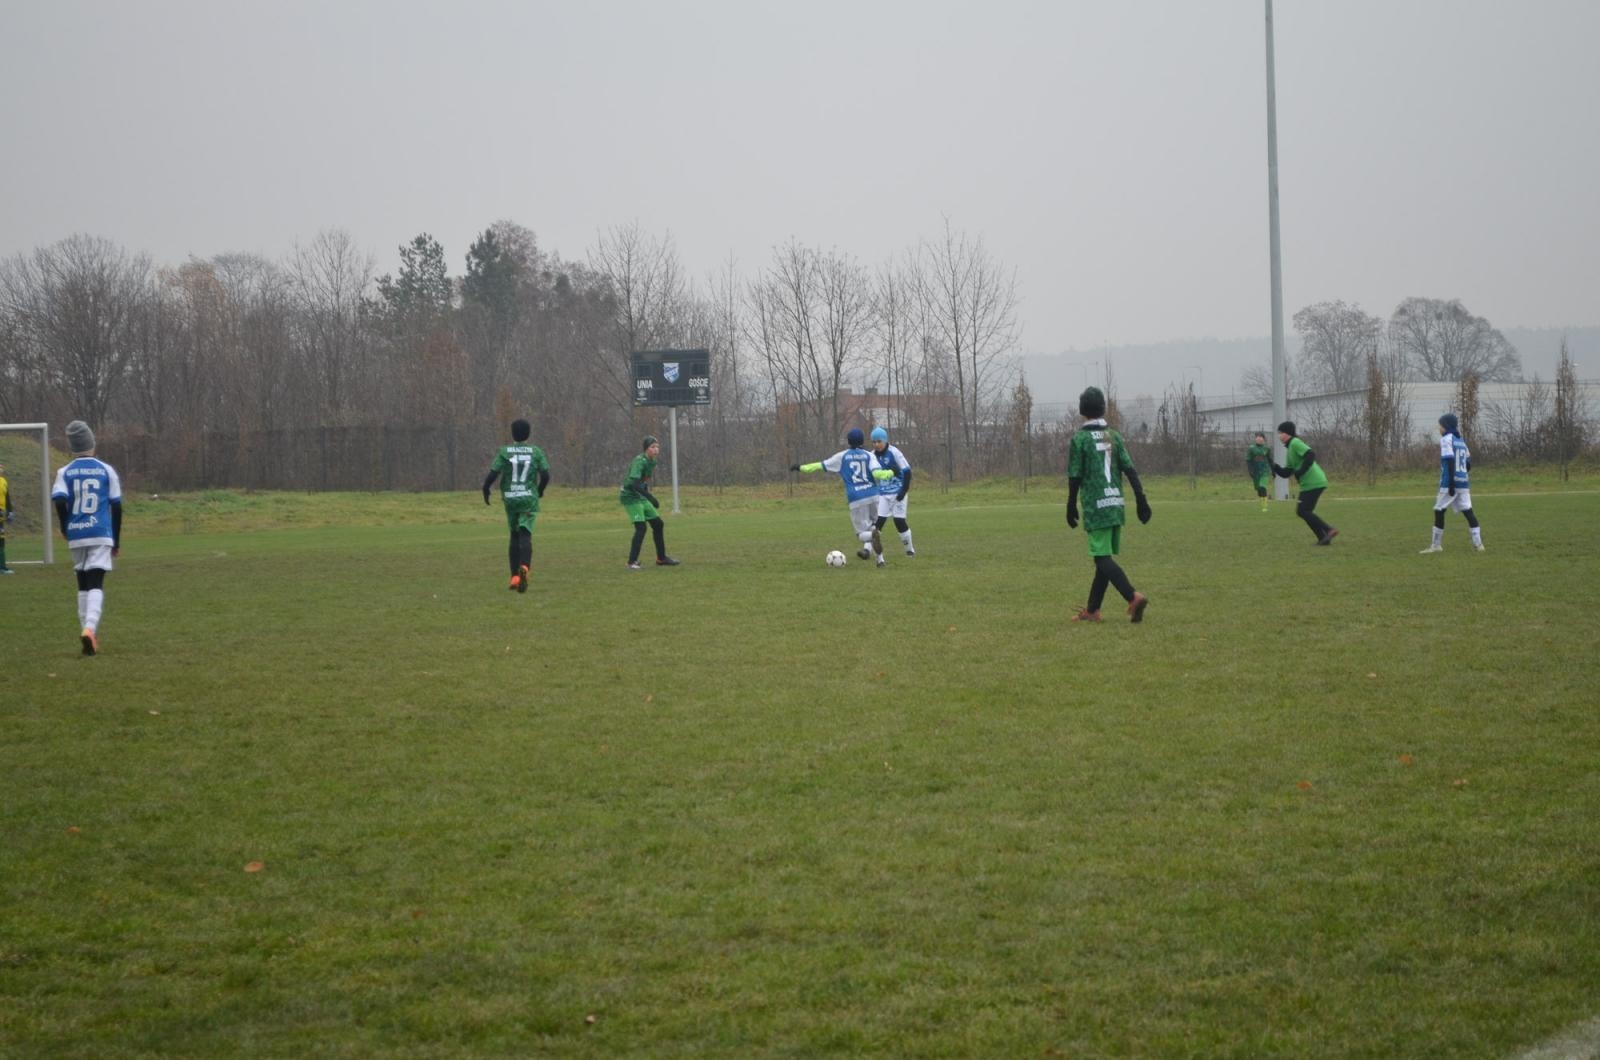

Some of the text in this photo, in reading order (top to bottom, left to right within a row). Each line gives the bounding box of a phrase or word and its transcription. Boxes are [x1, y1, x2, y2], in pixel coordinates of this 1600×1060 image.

[637, 379, 653, 389] UNIA
[508, 454, 532, 482] 17
[849, 460, 869, 484] 21
[1455, 448, 1468, 473] 13
[71, 478, 100, 515] 16
